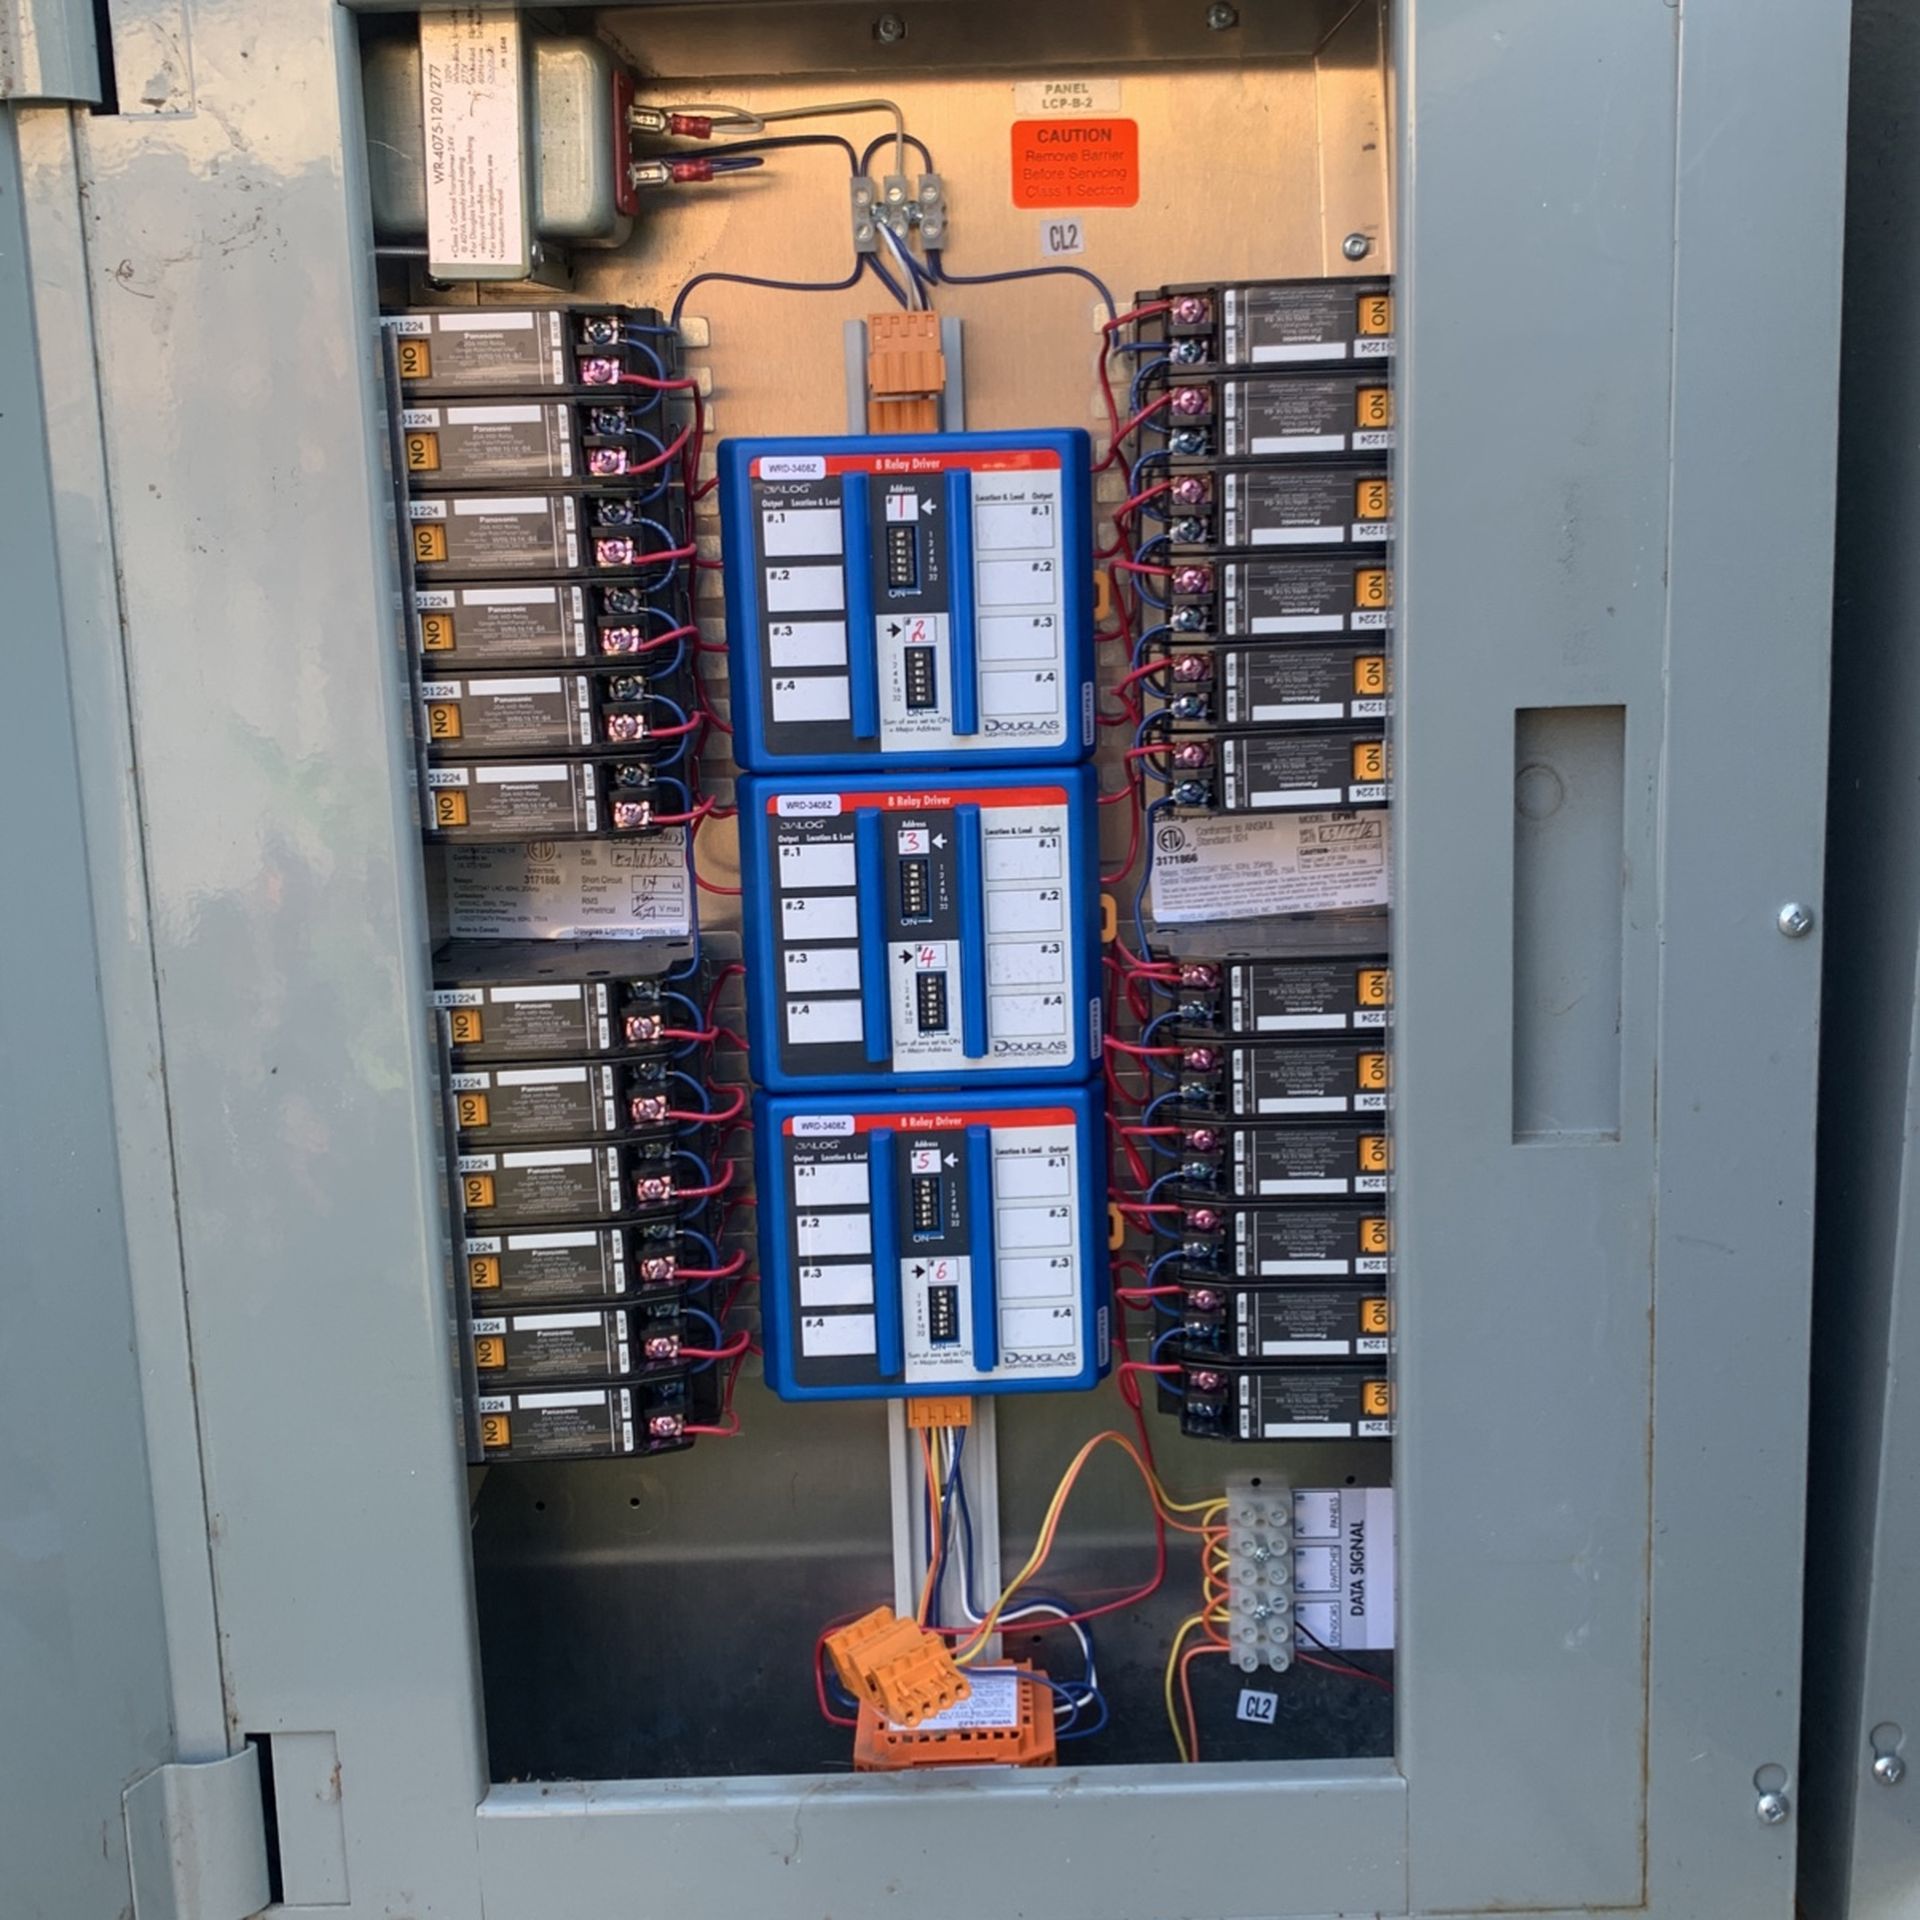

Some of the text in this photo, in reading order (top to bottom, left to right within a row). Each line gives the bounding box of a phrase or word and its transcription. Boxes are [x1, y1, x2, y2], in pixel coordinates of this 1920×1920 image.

[1045, 83, 1089, 95] PANEL
[1042, 98, 1093, 110] LCP-B-2
[430, 64, 445, 185] WR-4075-120/277
[1037, 128, 1112, 144] CAUTION
[1026, 149, 1124, 162] Remove Barrier
[1023, 168, 1065, 180] Before
[1050, 224, 1079, 251] CL2
[876, 458, 941, 472] 8 Relay Driver
[890, 484, 915, 493] Address
[888, 590, 906, 598] ON
[912, 620, 926, 643] 2
[985, 719, 1059, 732] DOUGLAS
[888, 795, 951, 808] 8 Relay Driver
[902, 820, 927, 828] Address
[904, 833, 920, 852] 3
[901, 918, 917, 926] ON
[920, 947, 936, 968] 4
[994, 1040, 1067, 1053] DOUGLAS
[902, 1116, 963, 1128] 8 Relay Driver
[914, 1140, 938, 1148] Address
[917, 1153, 930, 1169] 5
[913, 1234, 929, 1243] ON
[936, 1262, 947, 1280] 6
[1004, 1352, 1077, 1364] DOUGLAS
[1330, 1497, 1338, 1529] PANELS
[1330, 1547, 1339, 1589] SWITCHES
[1350, 1520, 1364, 1617] DATA SIGNAL
[1330, 1604, 1338, 1644] SENSORS
[1246, 1696, 1272, 1719] CL2
